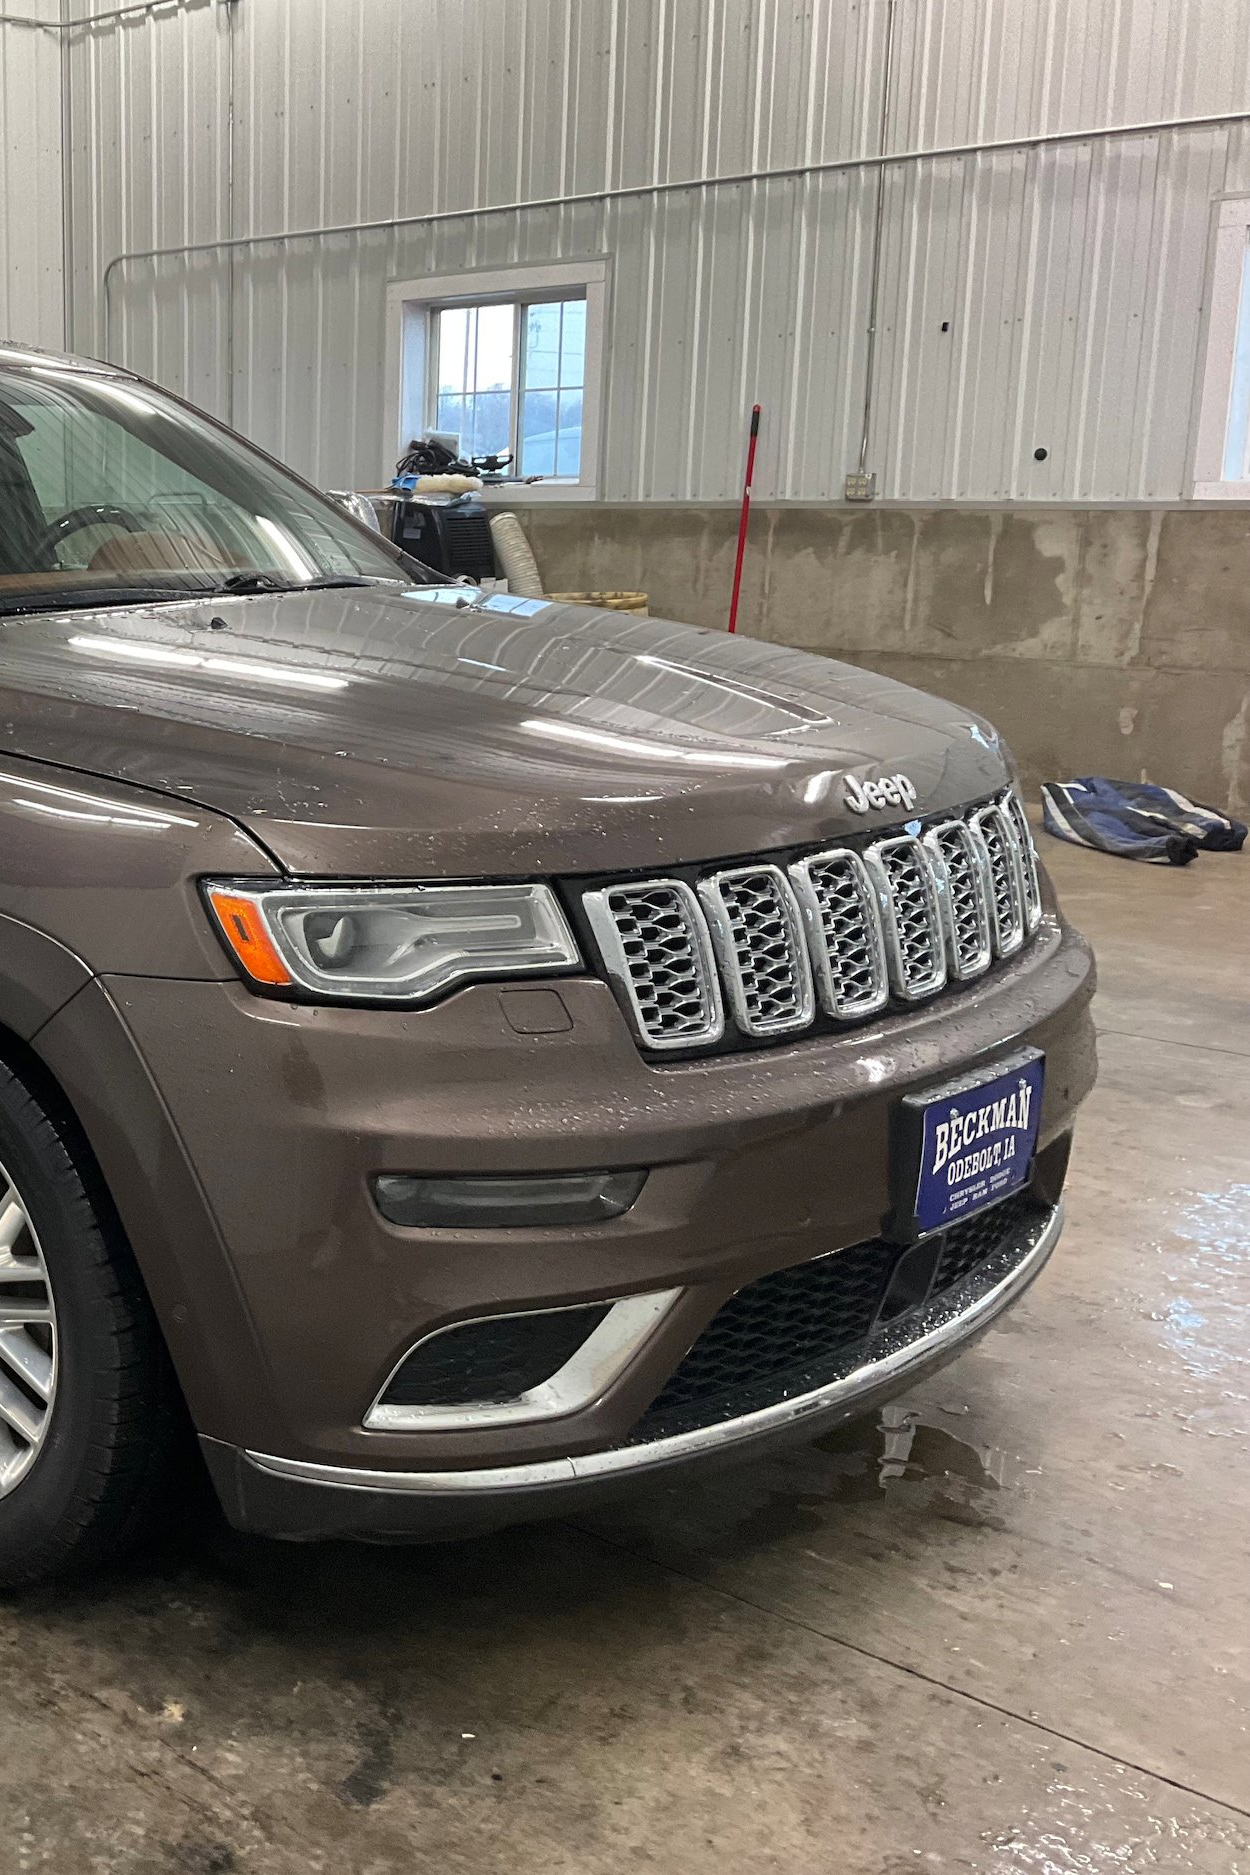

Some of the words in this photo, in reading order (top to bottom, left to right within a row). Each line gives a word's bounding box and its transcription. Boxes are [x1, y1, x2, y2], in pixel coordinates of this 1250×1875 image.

[844, 773, 917, 813] Jeep
[932, 1086, 1032, 1175] BECKMAN
[948, 1142, 1001, 1185] ODEBOLT,
[1003, 1135, 1015, 1160] IA
[950, 1180, 986, 1201] CHRYSLER
